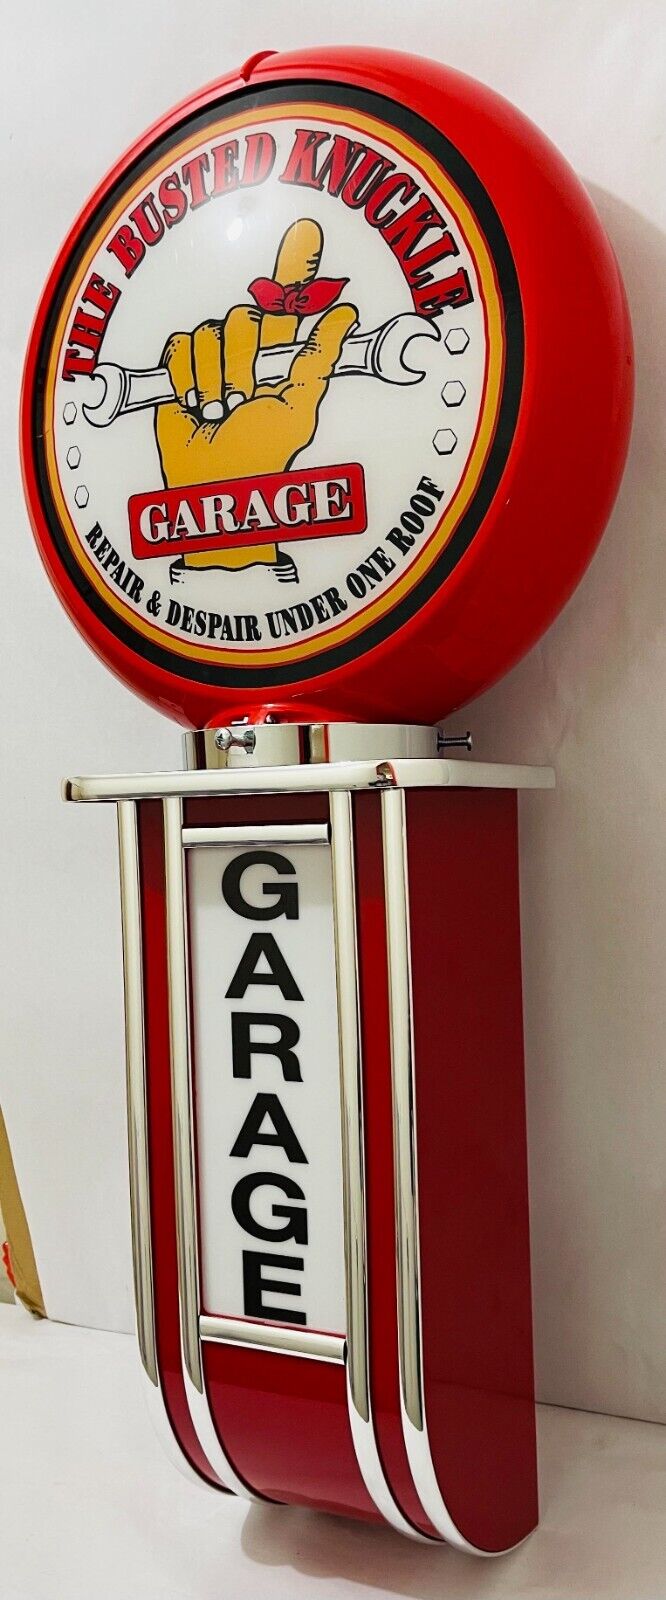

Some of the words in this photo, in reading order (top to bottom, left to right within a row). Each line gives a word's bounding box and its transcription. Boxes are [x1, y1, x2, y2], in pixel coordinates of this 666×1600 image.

[62, 272, 121, 382] THE
[106, 132, 277, 278] BUSTED
[279, 129, 474, 319] KNUCKLE
[85, 521, 146, 604] REPAIR
[146, 590, 162, 616] &
[165, 599, 262, 642] DESPAIR
[265, 586, 348, 639] UNDER
[346, 537, 397, 599] ONE
[385, 475, 445, 557] ROOF
[139, 478, 352, 545] GARAGE
[221, 850, 309, 1326] GARAGE
